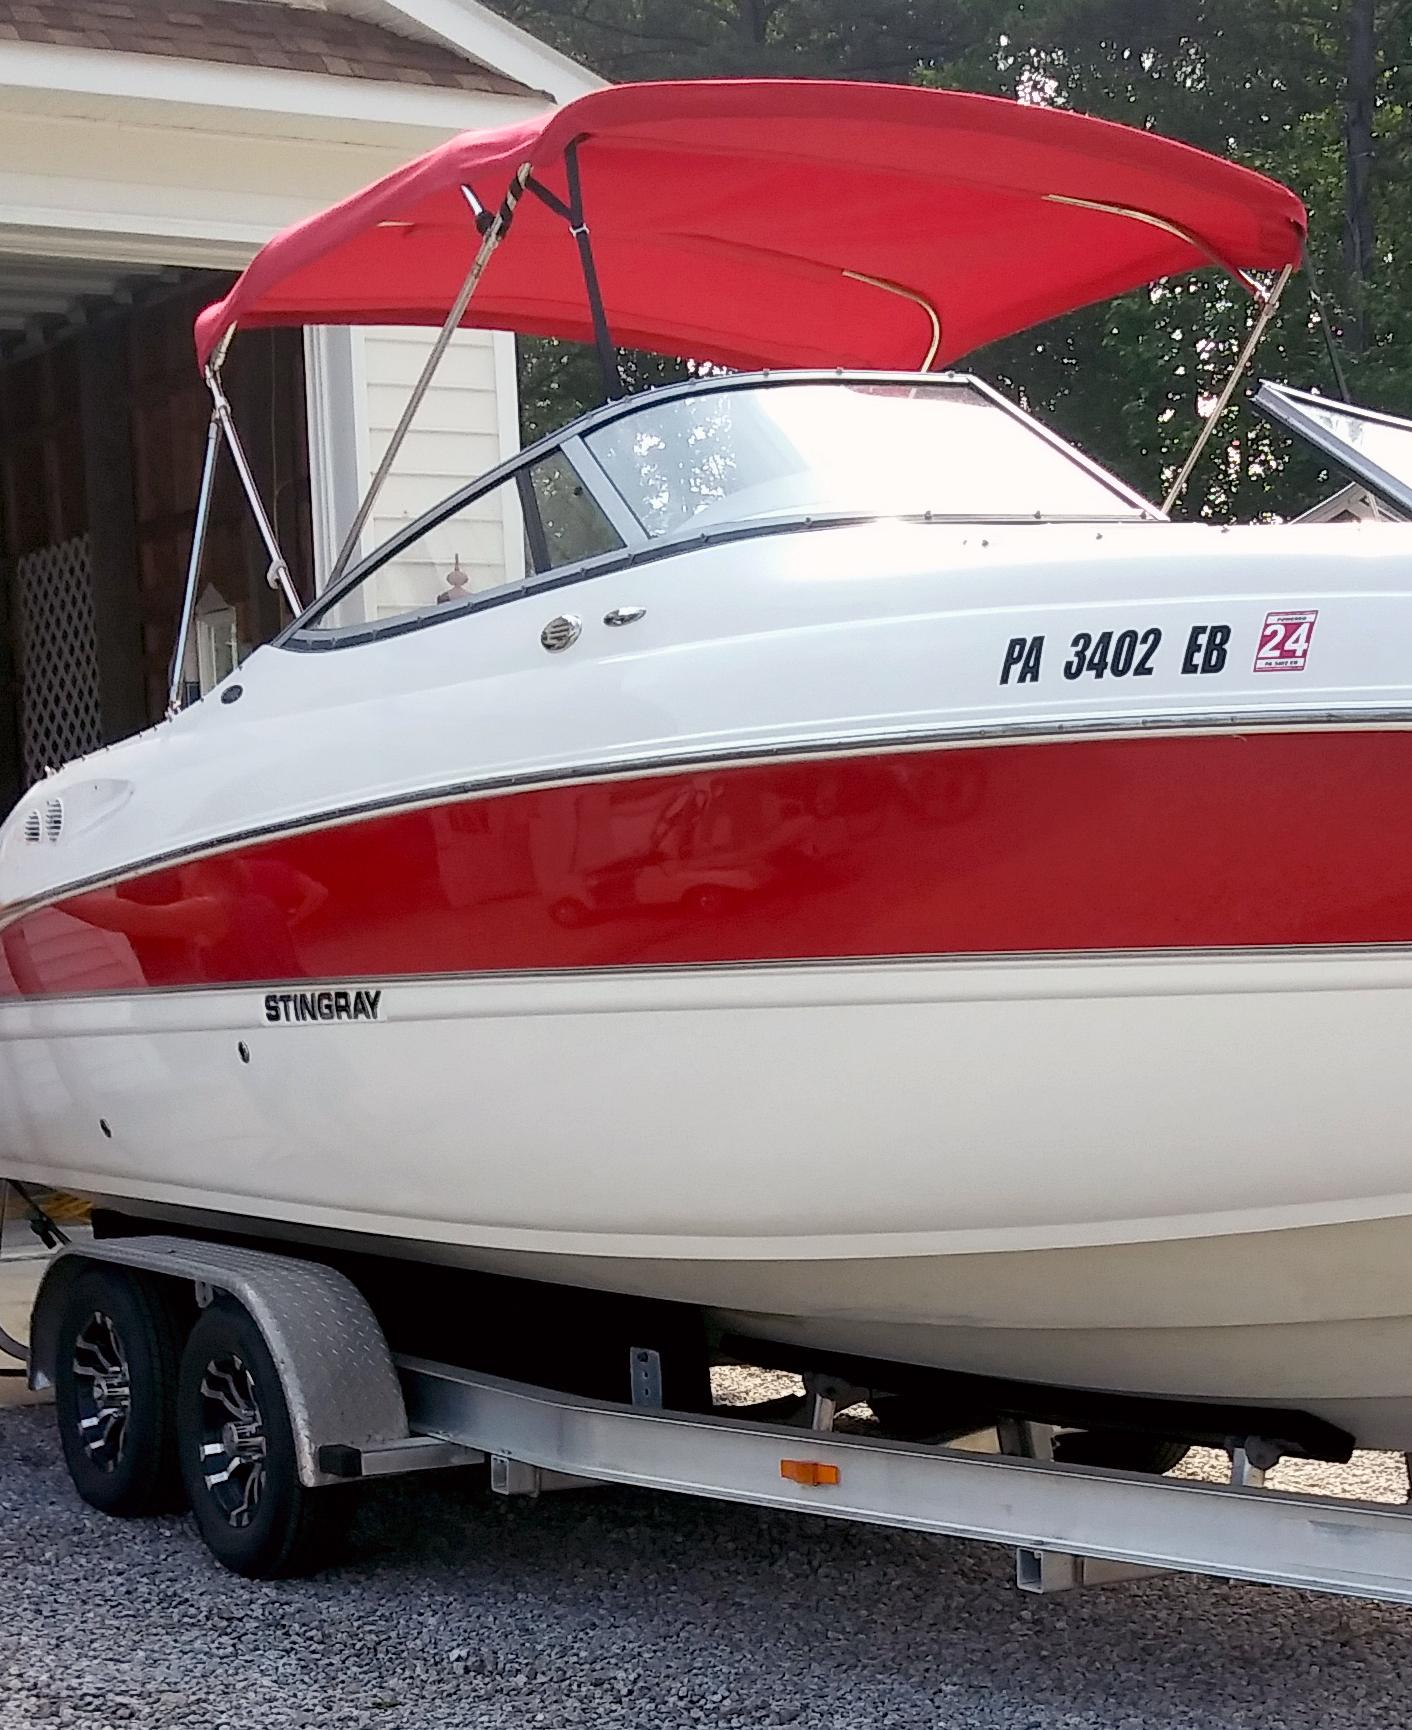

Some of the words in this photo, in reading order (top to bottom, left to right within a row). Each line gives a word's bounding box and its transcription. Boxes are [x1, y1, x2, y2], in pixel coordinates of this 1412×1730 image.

[1000, 636, 1045, 686] PA
[1063, 627, 1162, 681] 3402
[1180, 625, 1232, 675] EB
[1258, 622, 1311, 658] 24
[264, 990, 382, 1022] STINGRAY
